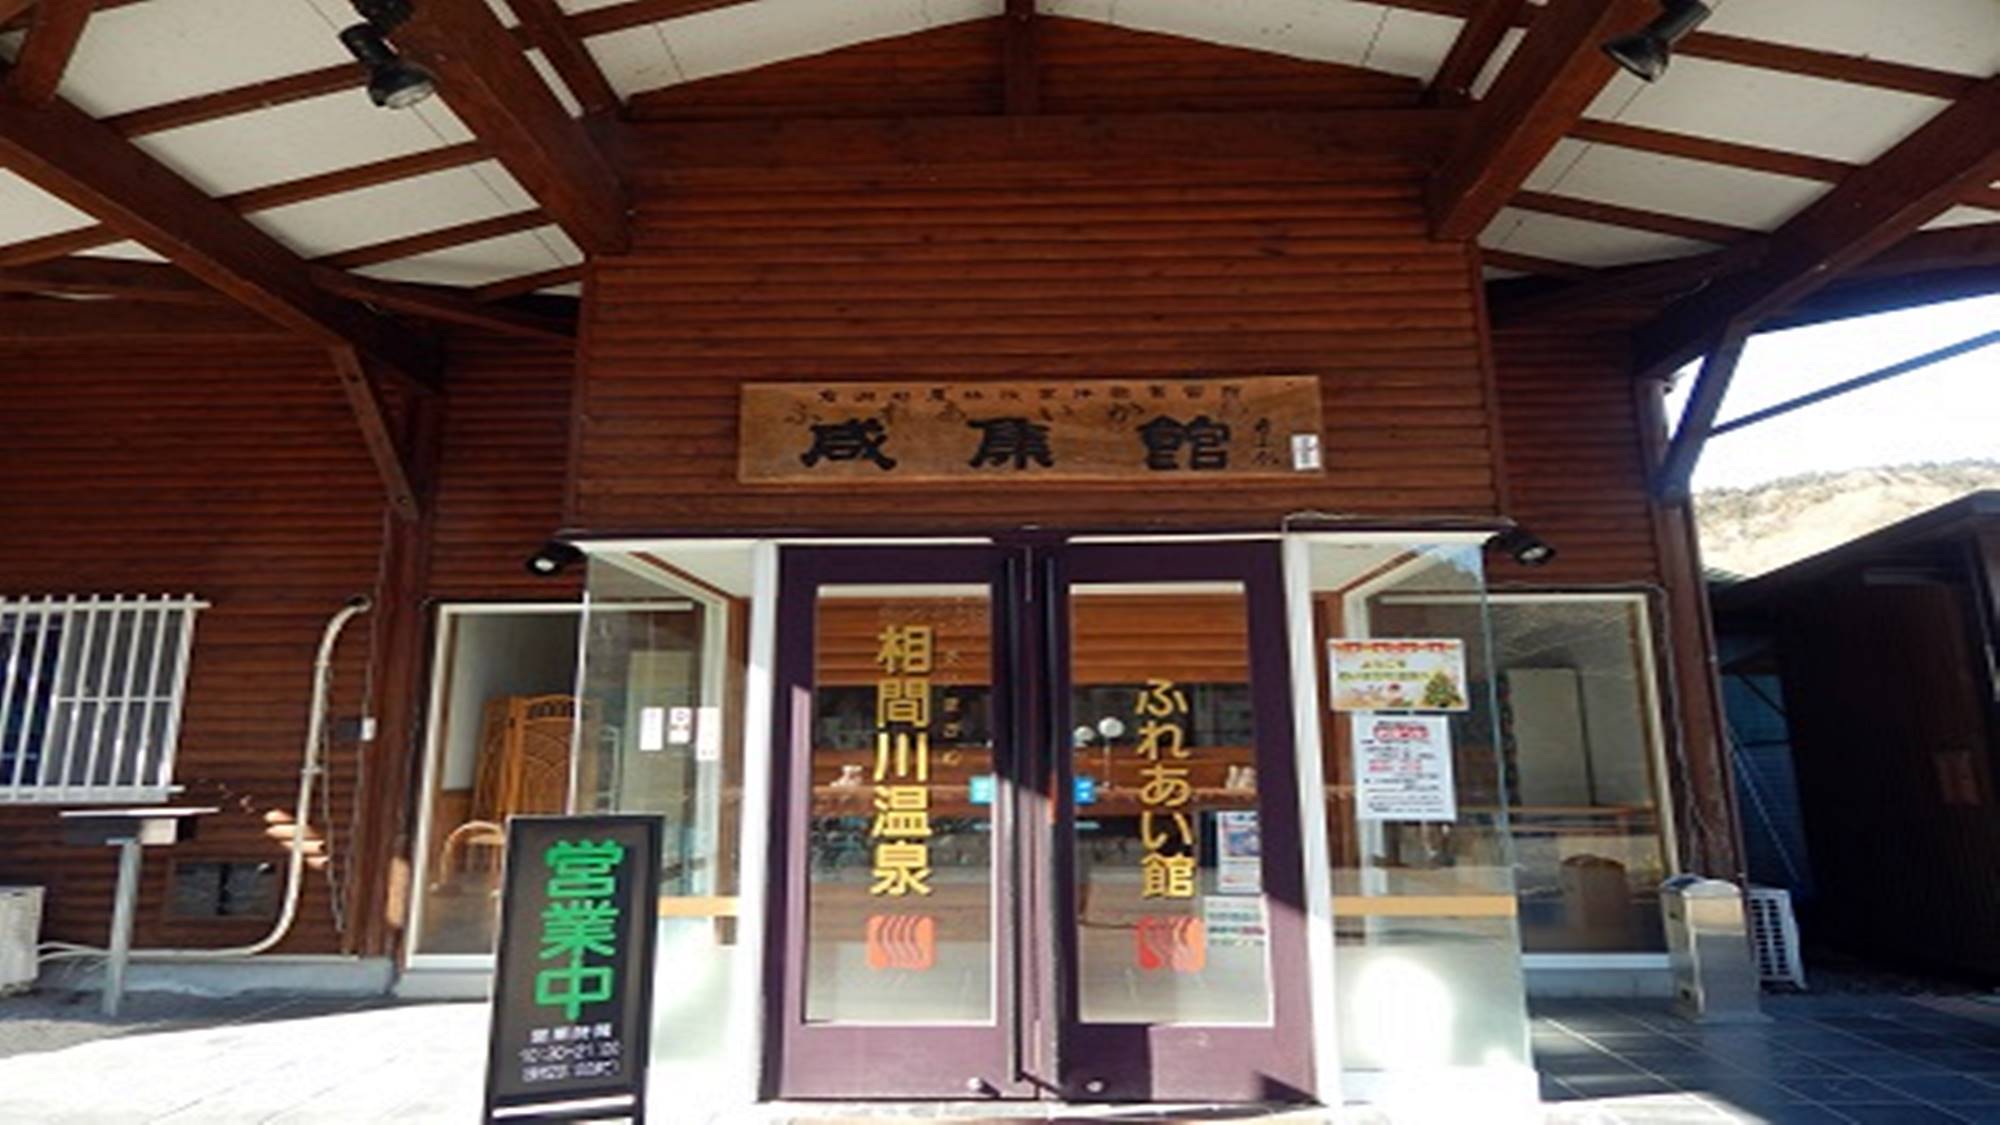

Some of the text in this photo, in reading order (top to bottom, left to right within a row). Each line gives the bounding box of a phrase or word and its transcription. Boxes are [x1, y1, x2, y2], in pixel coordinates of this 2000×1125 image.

[870, 624, 932, 896] 相間川温泉
[1135, 678, 1196, 898] ふれあい館
[534, 838, 625, 1021] 営業中
